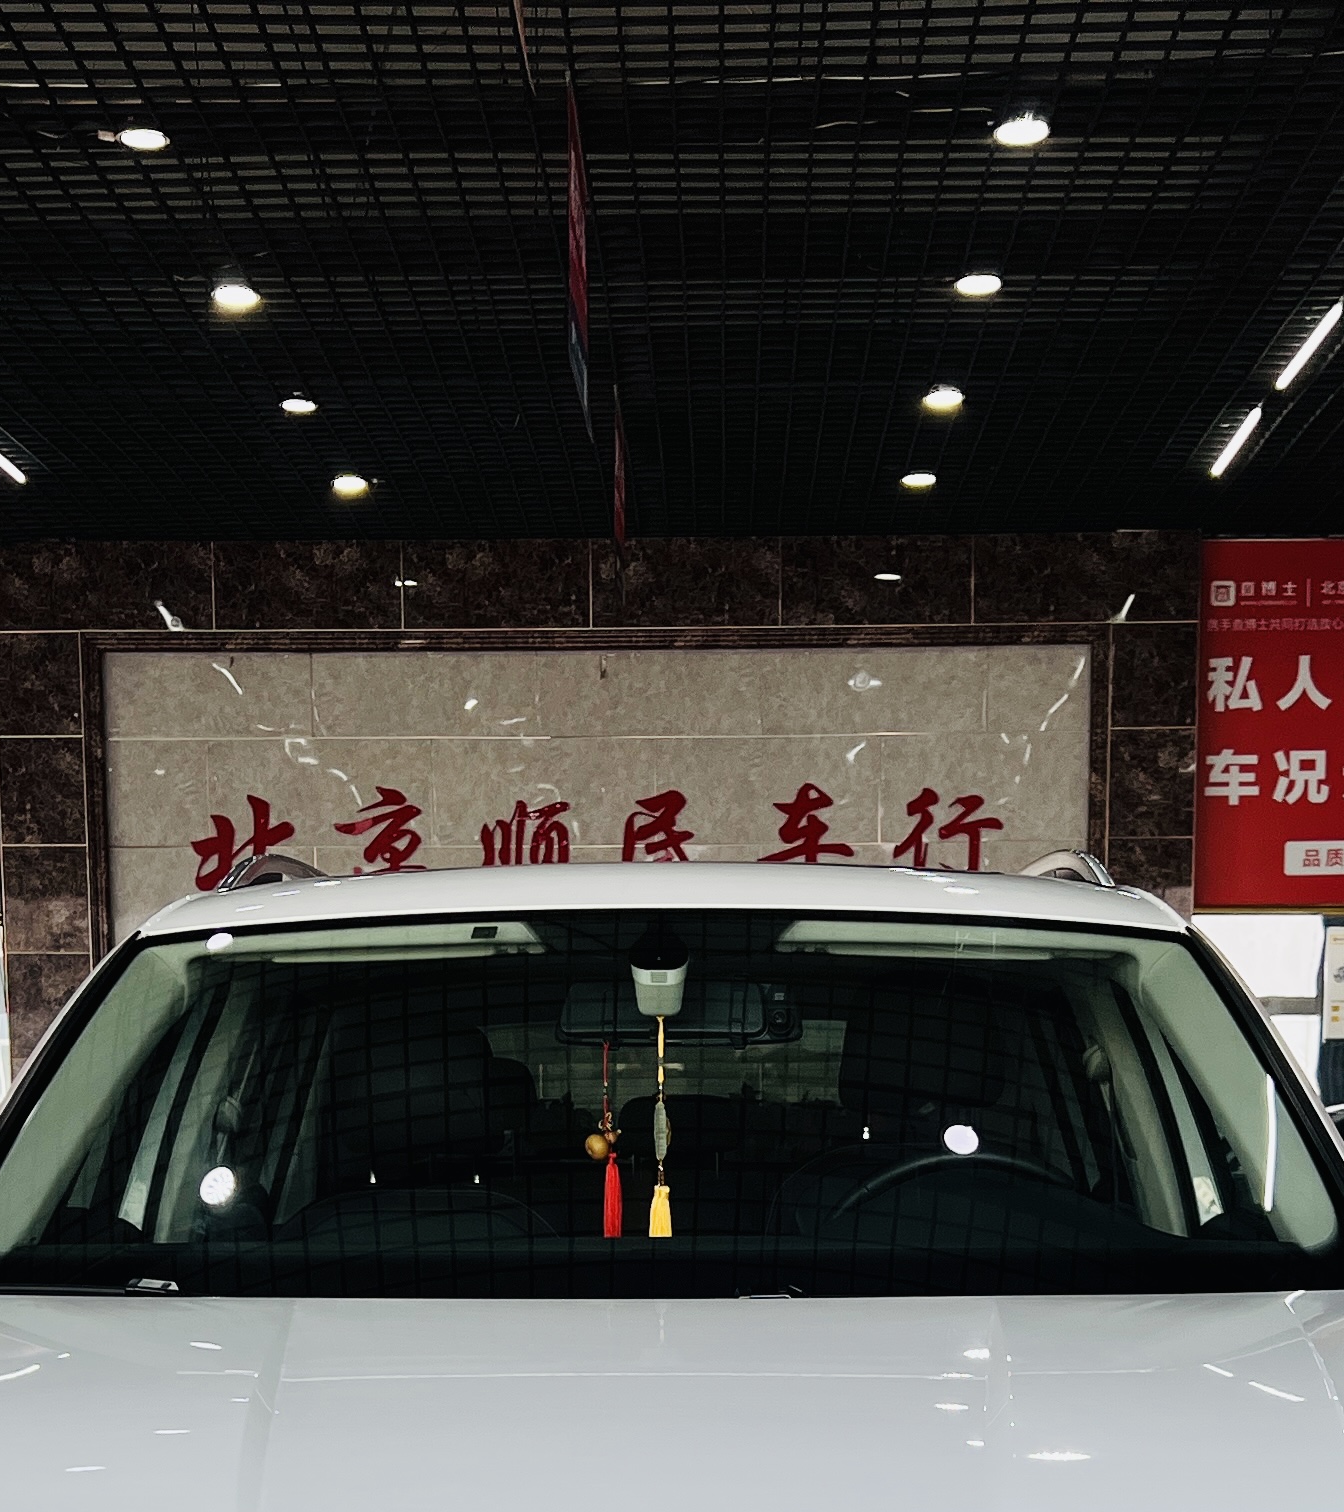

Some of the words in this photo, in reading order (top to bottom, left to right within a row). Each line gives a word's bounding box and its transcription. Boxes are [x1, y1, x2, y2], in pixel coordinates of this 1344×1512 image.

[191, 783, 1003, 892] 北京顺民车行
